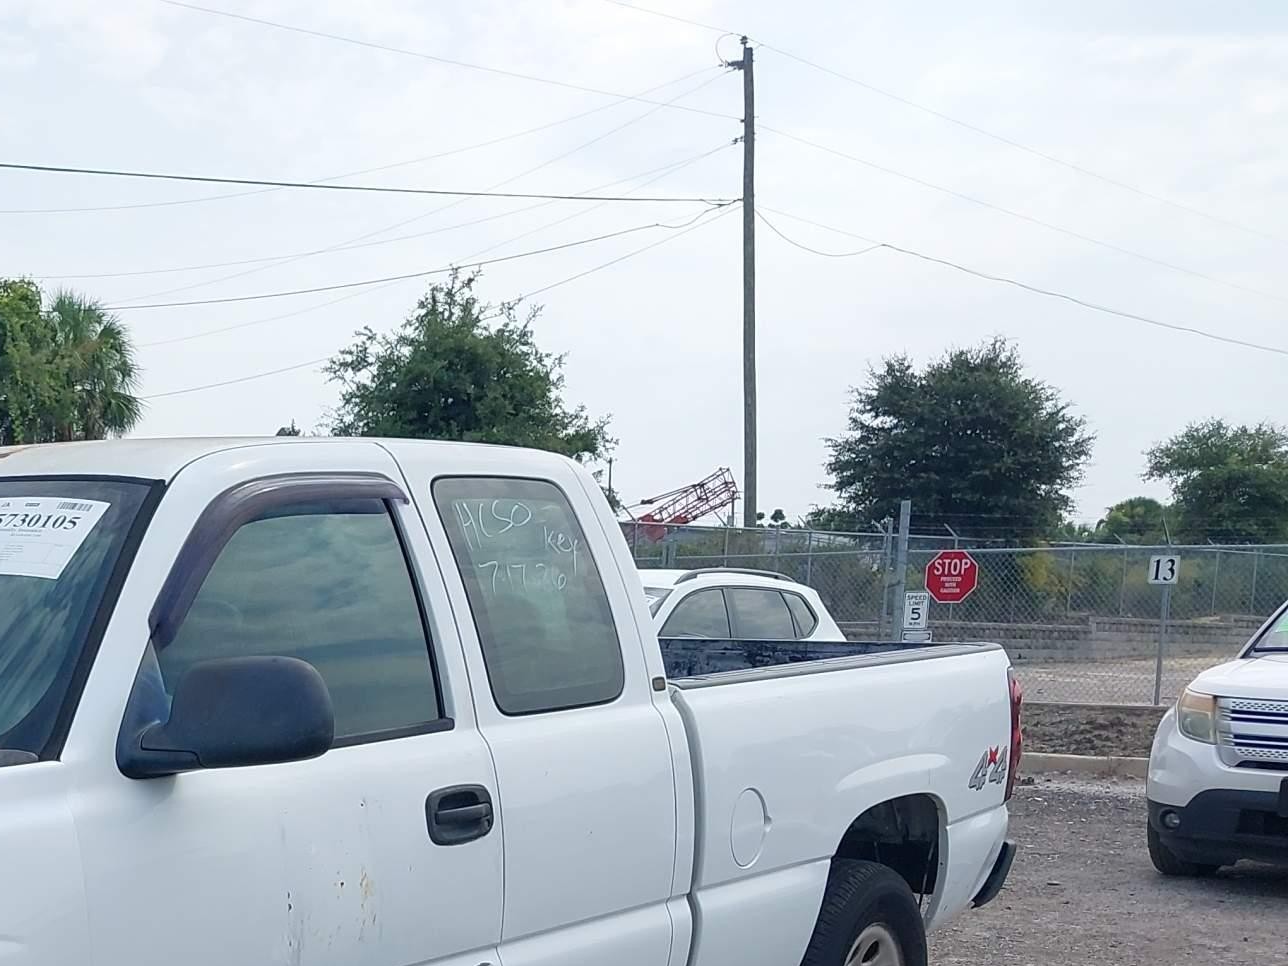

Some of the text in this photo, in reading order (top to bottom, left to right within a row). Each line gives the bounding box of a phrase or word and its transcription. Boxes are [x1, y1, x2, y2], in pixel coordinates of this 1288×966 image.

[934, 559, 971, 575] STOP
[1152, 558, 1176, 581] 13
[910, 607, 921, 621] 5
